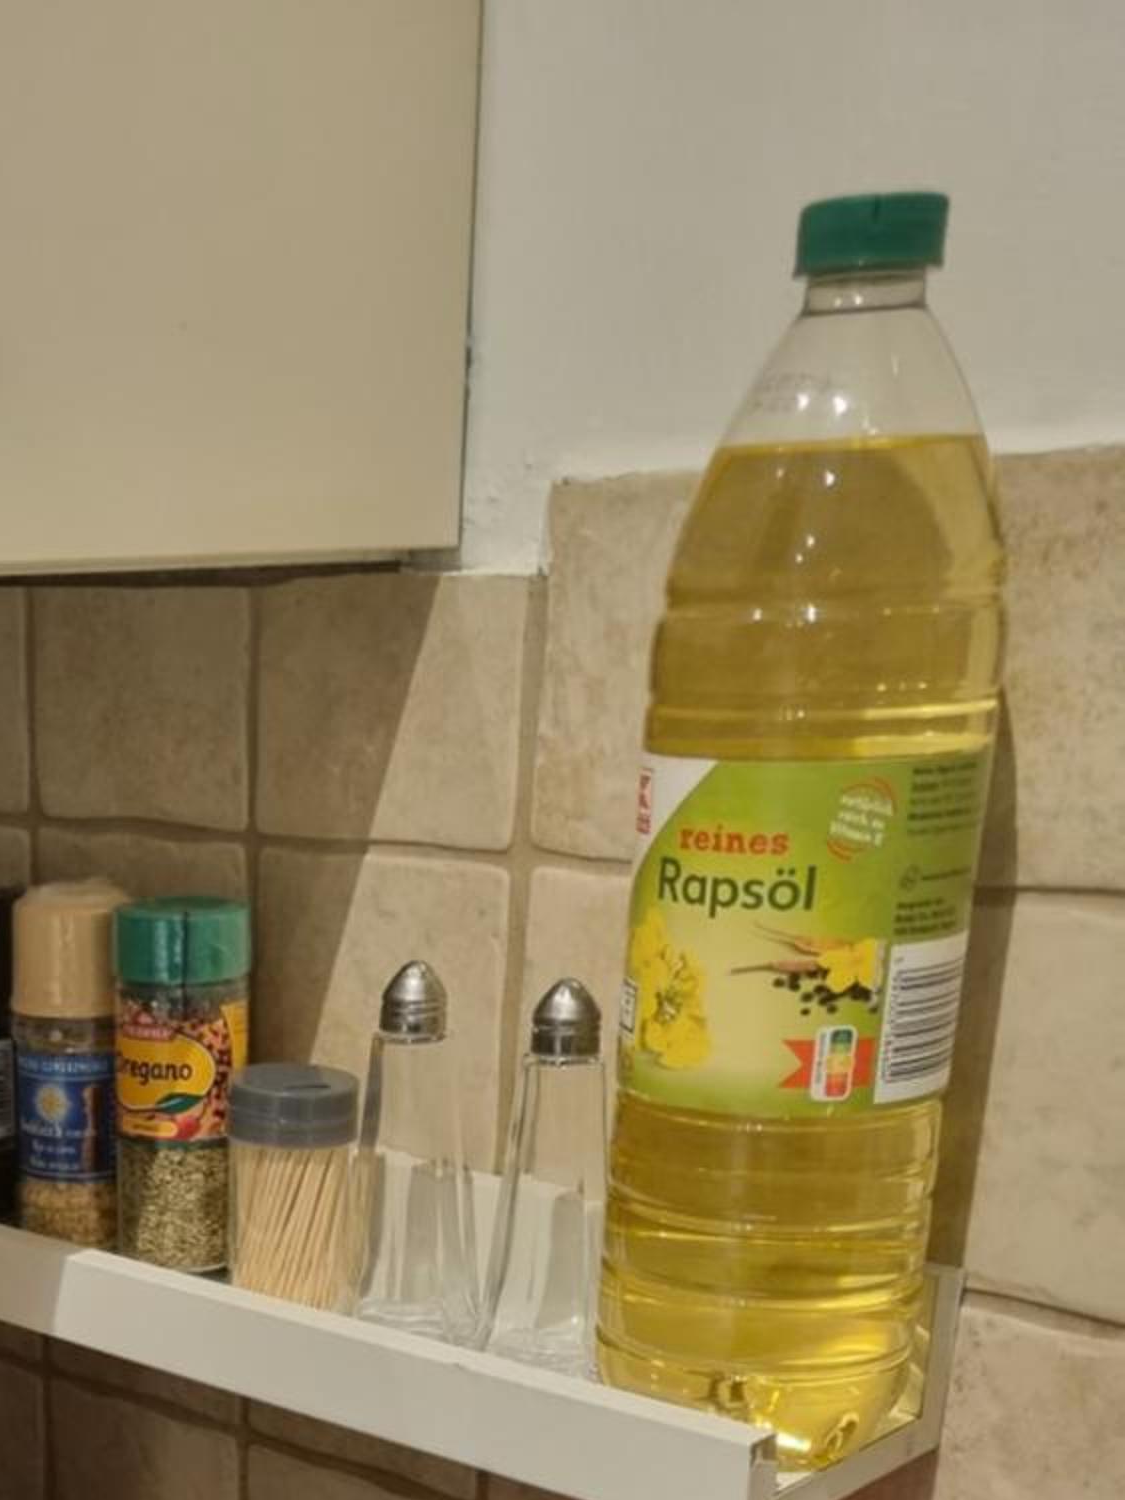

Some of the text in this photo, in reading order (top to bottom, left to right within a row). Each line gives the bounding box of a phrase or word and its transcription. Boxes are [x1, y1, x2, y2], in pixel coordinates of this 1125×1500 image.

[678, 825, 791, 856] reines
[657, 856, 818, 918] Rapsöl
[115, 1053, 193, 1087] regano
